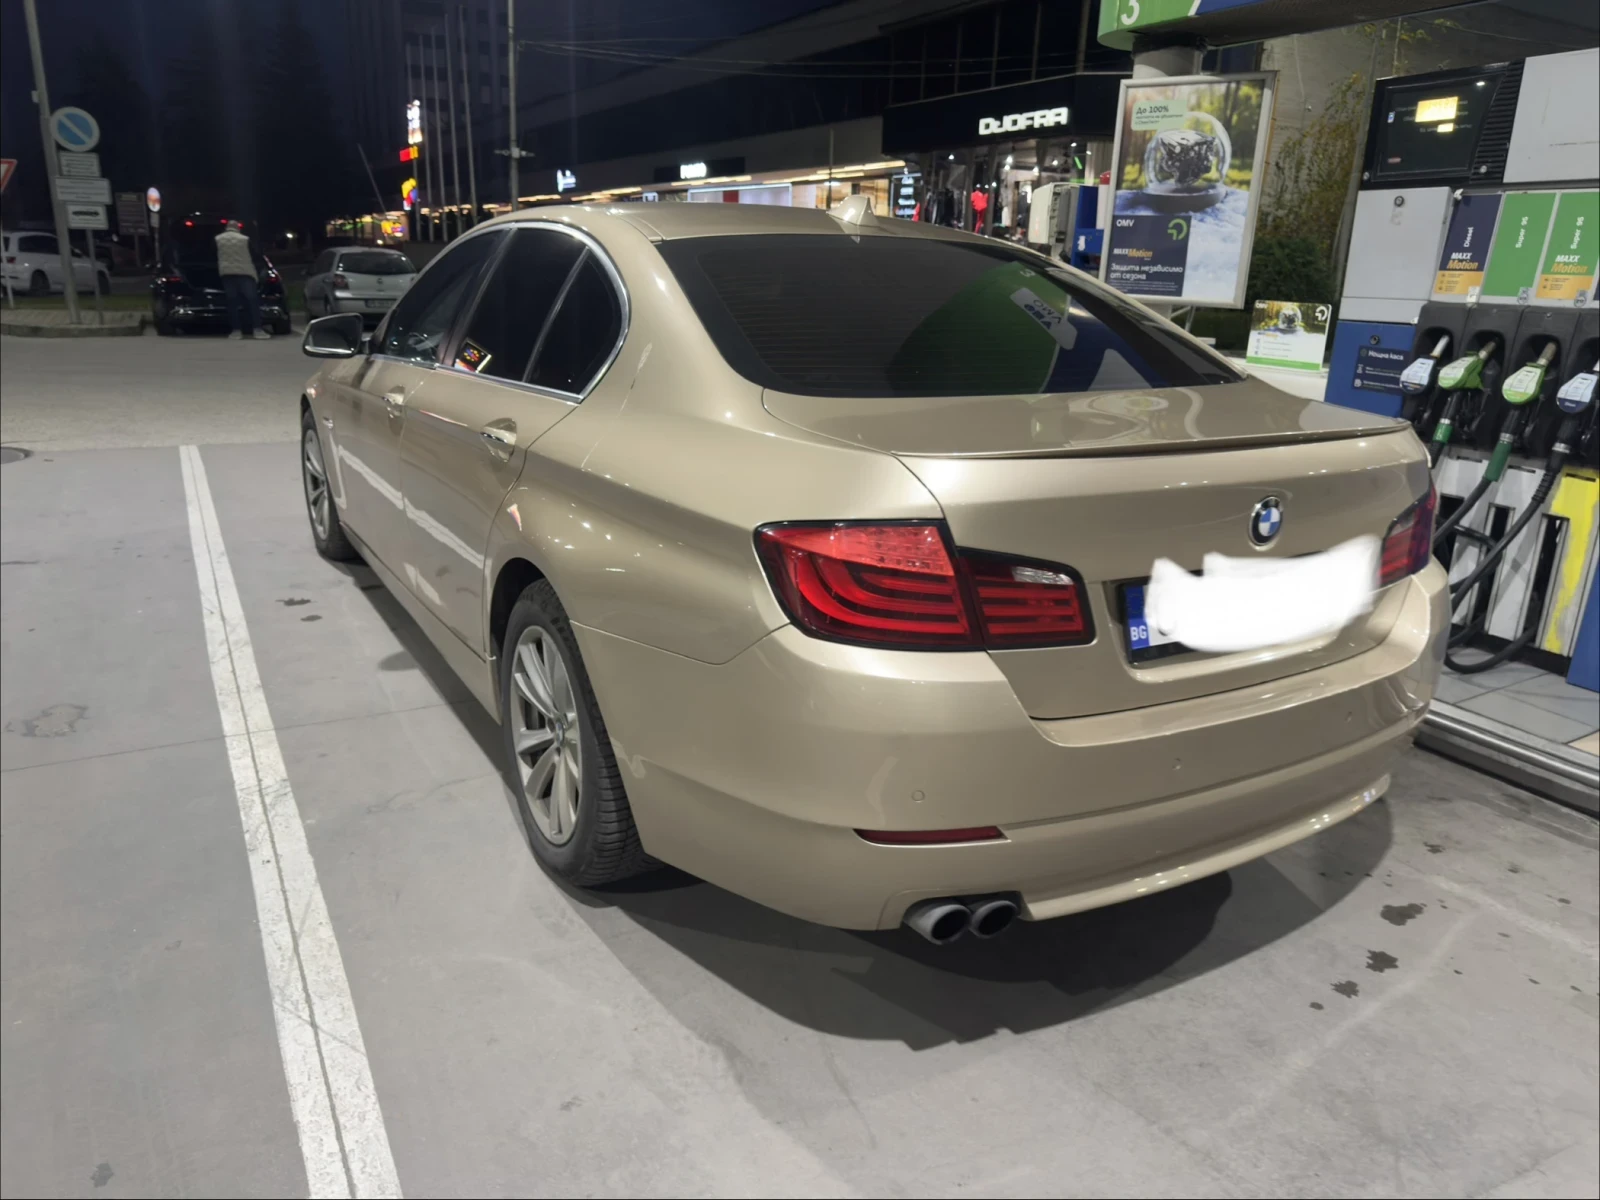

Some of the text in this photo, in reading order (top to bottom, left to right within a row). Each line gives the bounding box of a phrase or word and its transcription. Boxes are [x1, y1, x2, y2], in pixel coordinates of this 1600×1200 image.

[1136, 105, 1169, 115] До 100%
[1116, 219, 1135, 227] OMV
[1463, 227, 1474, 247] Diesel
[1515, 216, 1529, 248] Super 95
[1570, 216, 1585, 249] Super 95
[1110, 263, 1183, 273] Защита независимо
[1446, 259, 1479, 270] Motion
[1551, 262, 1588, 273] Motion
[1130, 625, 1147, 641] BG
